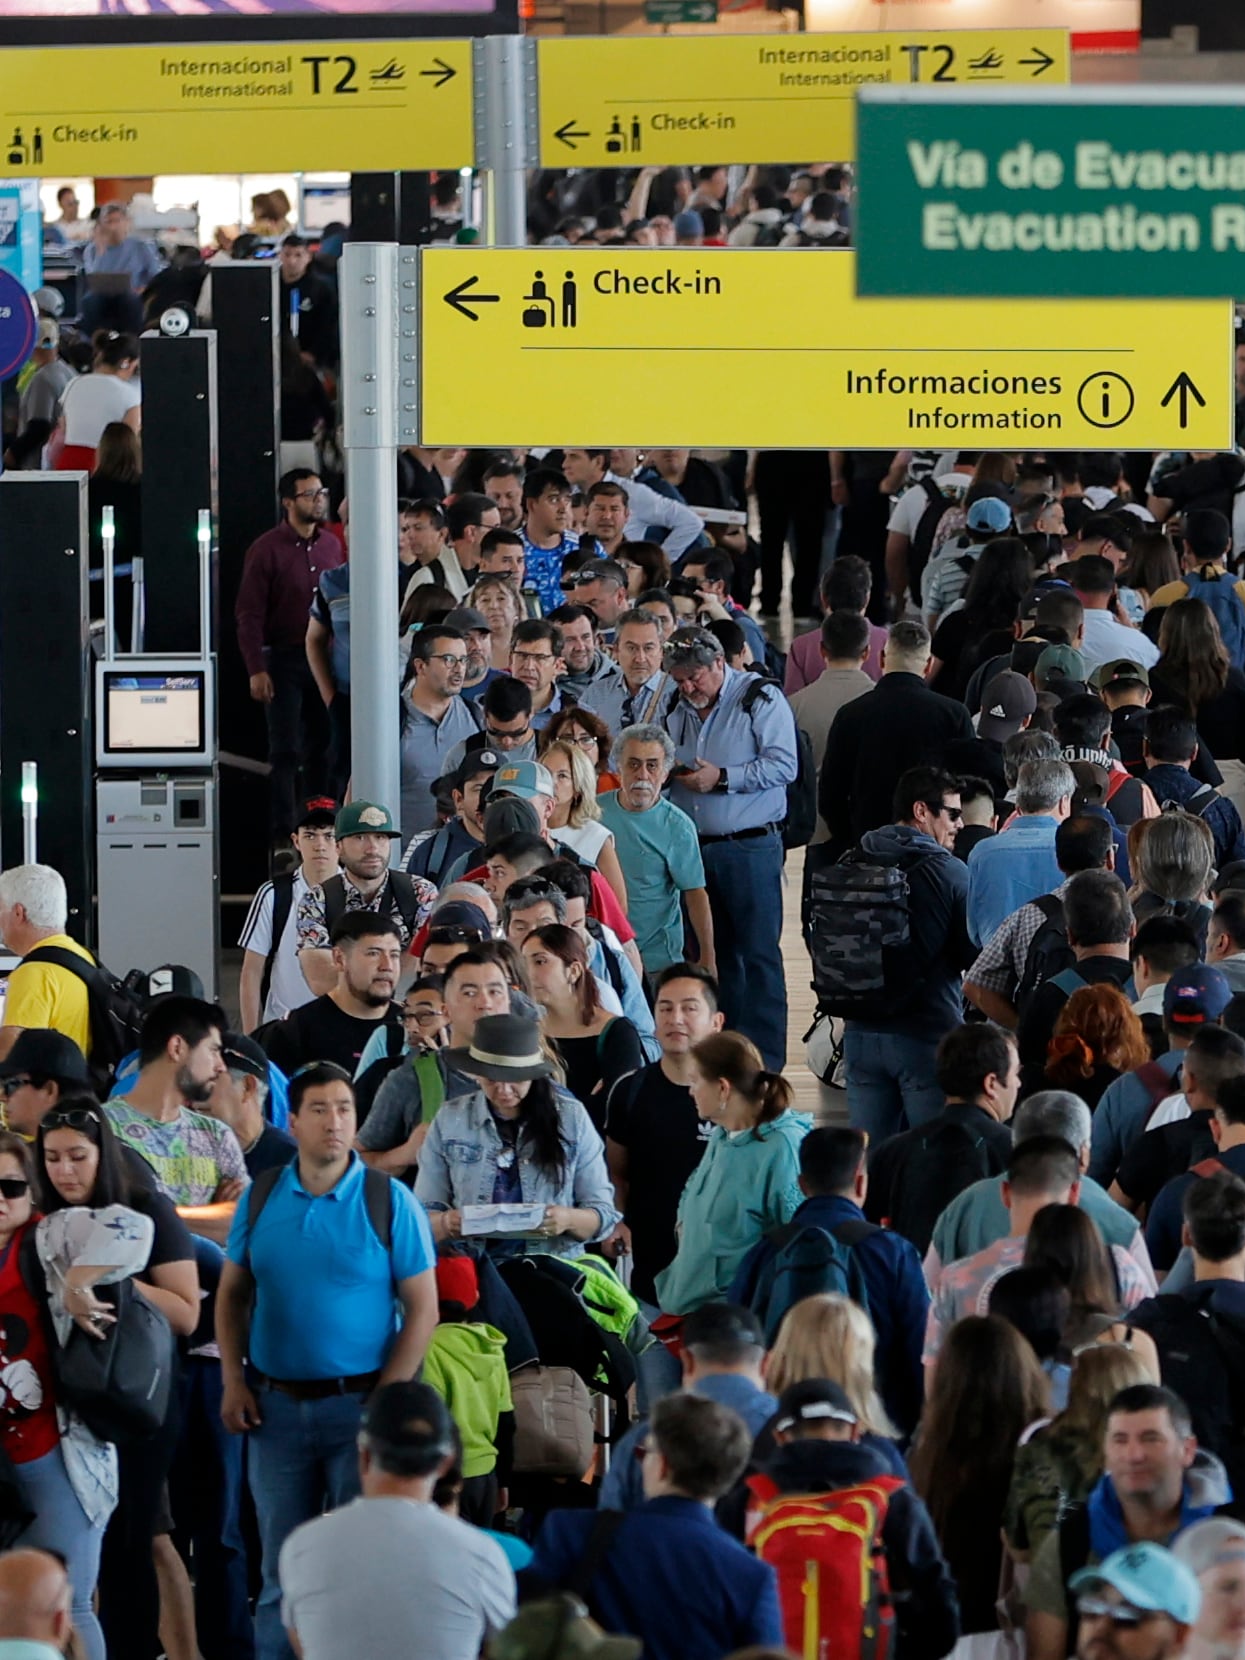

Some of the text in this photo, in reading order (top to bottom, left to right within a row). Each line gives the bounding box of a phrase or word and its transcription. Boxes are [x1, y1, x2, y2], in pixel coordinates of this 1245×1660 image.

[160, 56, 292, 76] Internacional
[758, 45, 891, 64] Internacional
[900, 45, 957, 83] T2
[302, 56, 359, 94] T2
[779, 70, 891, 87] International
[181, 81, 293, 99] International
[52, 124, 138, 143] Check-in
[650, 112, 736, 131] Check-in
[907, 140, 987, 189] Vía
[999, 142, 1064, 190] de
[923, 204, 1200, 252] Evacuation
[593, 268, 722, 295] Check-in
[847, 368, 1062, 395] Informaciones
[908, 406, 1062, 430] Information
